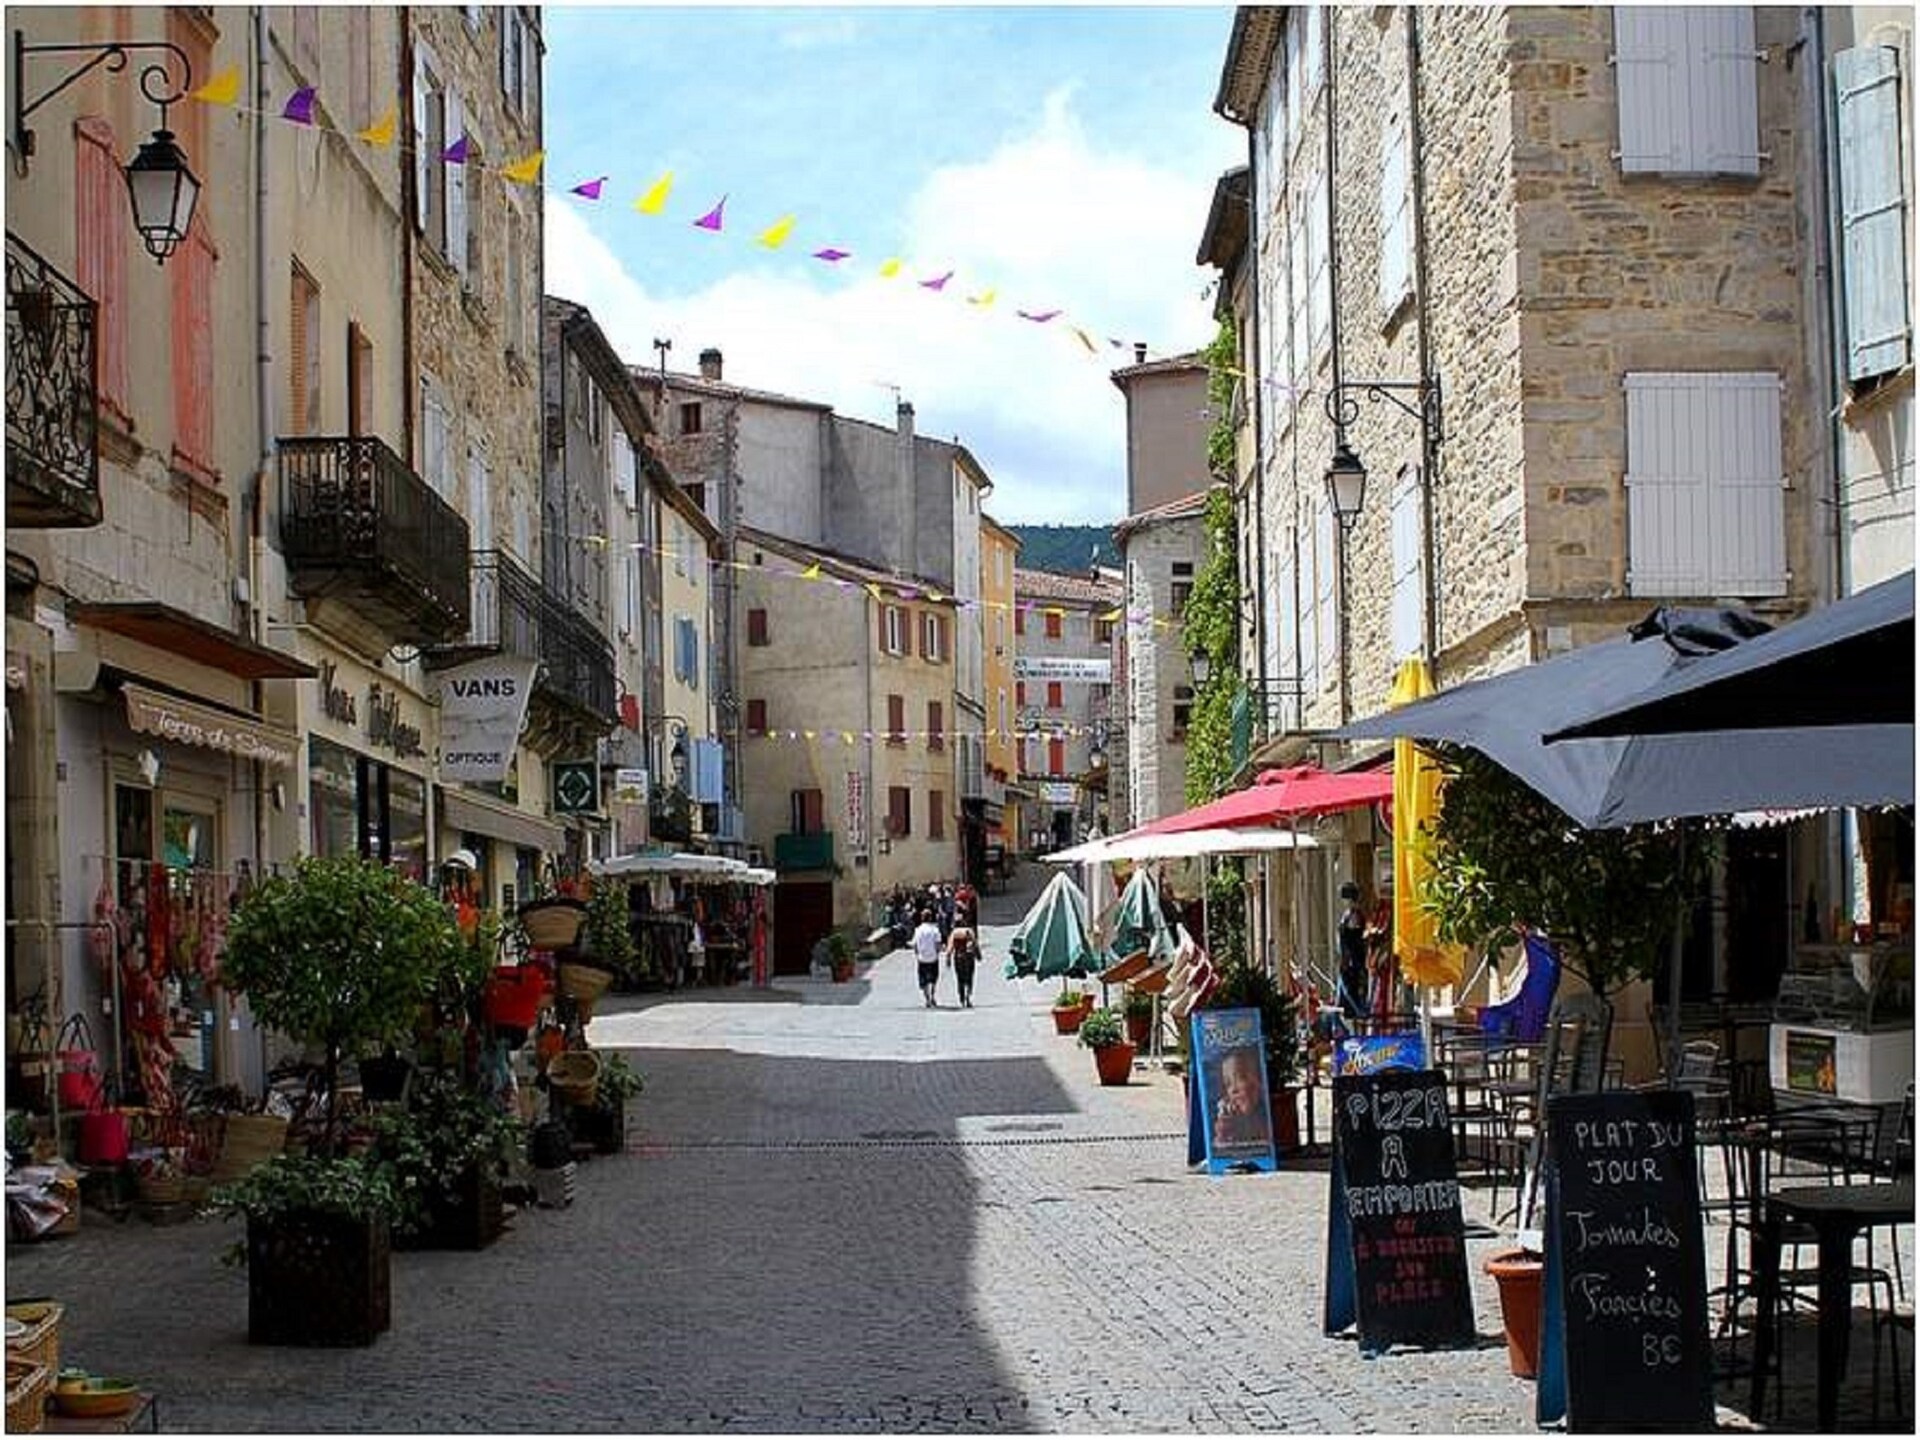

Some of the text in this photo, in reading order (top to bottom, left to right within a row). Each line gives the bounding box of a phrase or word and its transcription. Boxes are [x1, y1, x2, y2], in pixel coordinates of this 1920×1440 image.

[452, 678, 516, 698] VANS
[445, 752, 502, 766] OPTIQUE
[1574, 1120, 1683, 1149] PLAT DU
[1381, 1135, 1407, 1178] A
[1587, 1158, 1663, 1185] JOUR
[1348, 1180, 1460, 1218] EMPORTER
[1566, 1206, 1680, 1252] Tomates
